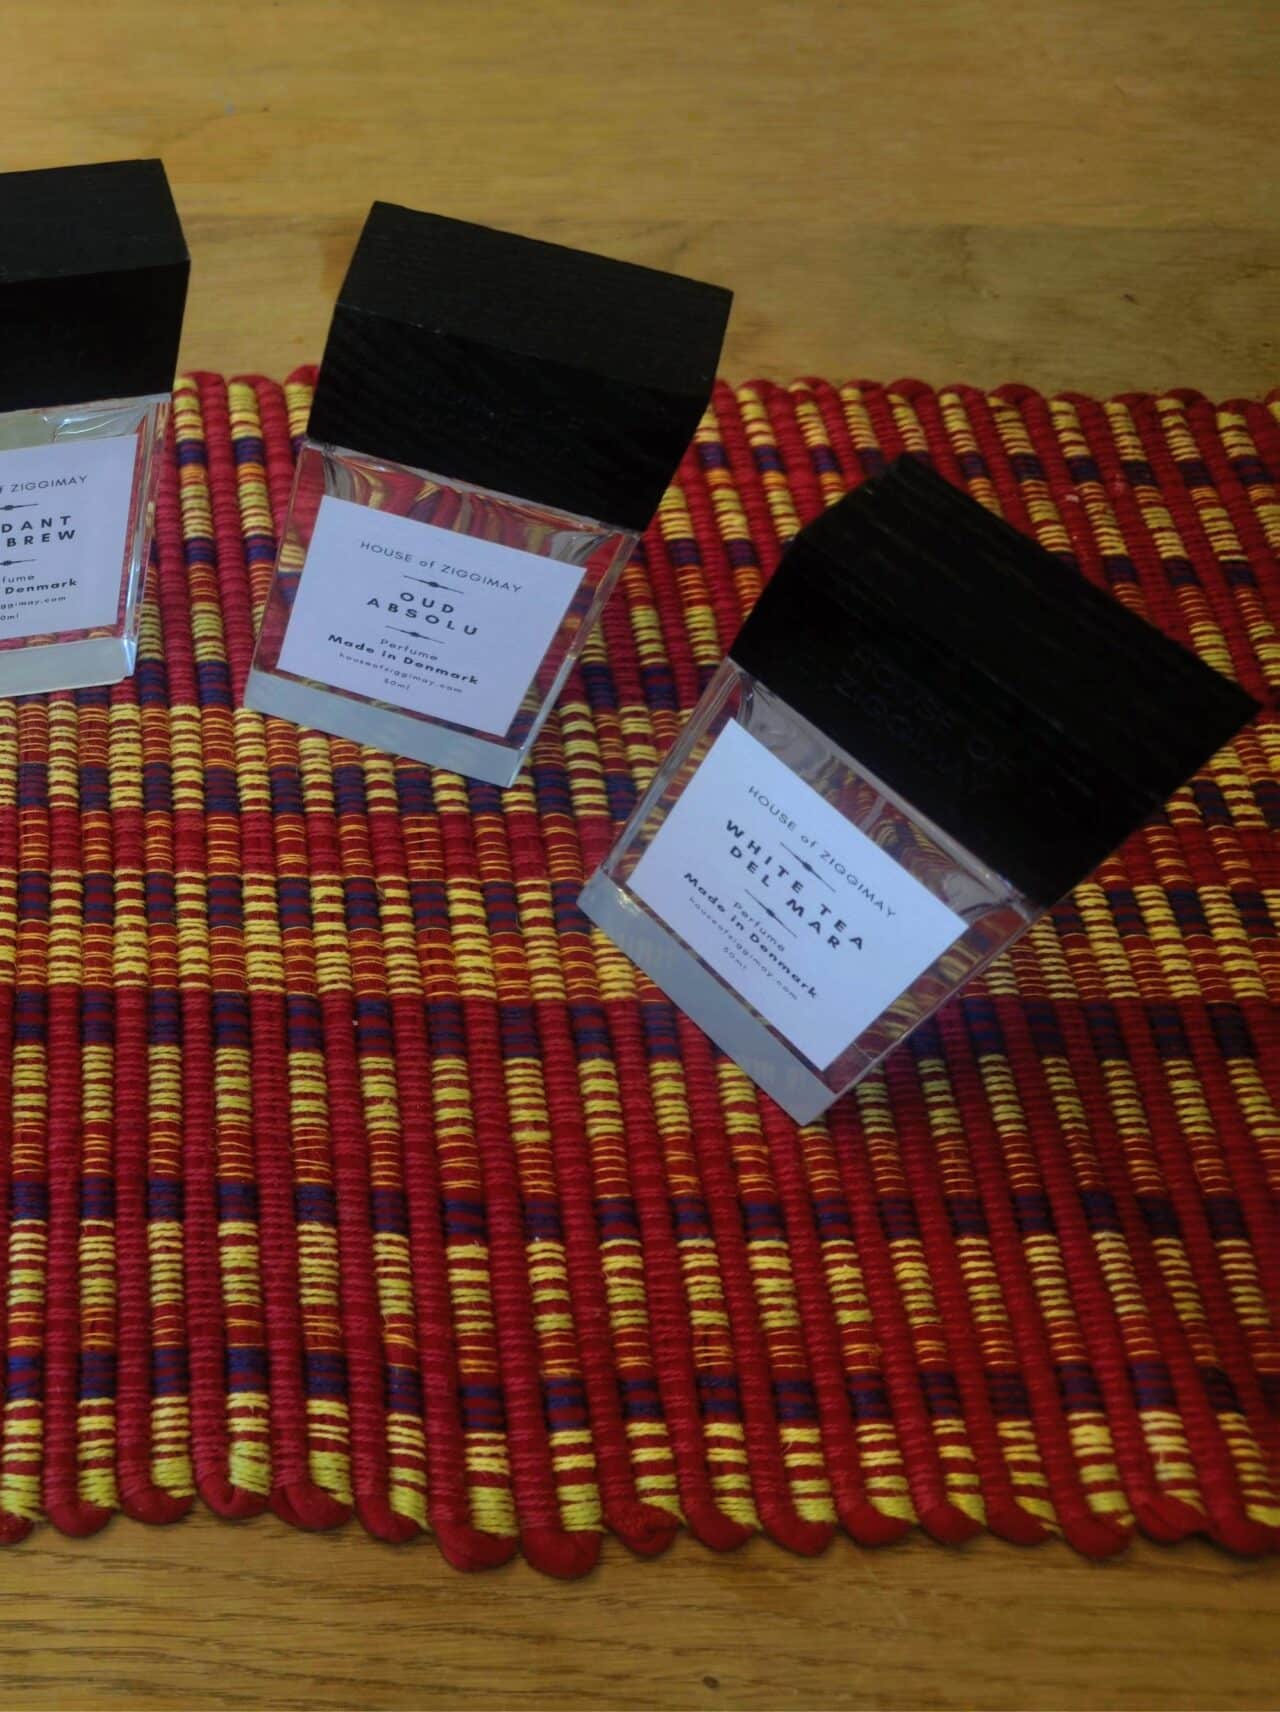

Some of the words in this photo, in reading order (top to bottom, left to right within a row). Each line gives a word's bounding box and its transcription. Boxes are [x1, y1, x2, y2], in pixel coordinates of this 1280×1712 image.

[10, 475, 88, 493] ZIGGIMAY
[7, 530, 75, 548] BREW
[5, 579, 77, 595] Denmark
[360, 541, 413, 563] HOUSE
[419, 559, 435, 568] of
[440, 564, 523, 593] ZIGGIMAY
[367, 597, 479, 636] ABSOLU
[400, 592, 454, 614] OUD
[327, 634, 375, 655] Made
[403, 656, 479, 685] Denmark
[380, 639, 439, 661] Perfume
[747, 785, 796, 832] HOUSE
[800, 834, 817, 848] of
[820, 850, 896, 918] ZIGGIMAY
[726, 820, 804, 894] WHITE
[820, 904, 864, 950] TEA
[729, 846, 771, 887] DEL
[786, 899, 840, 949] MAR
[684, 872, 726, 912] Made
[749, 933, 818, 998] Denmark
[733, 901, 785, 951] Perfume
